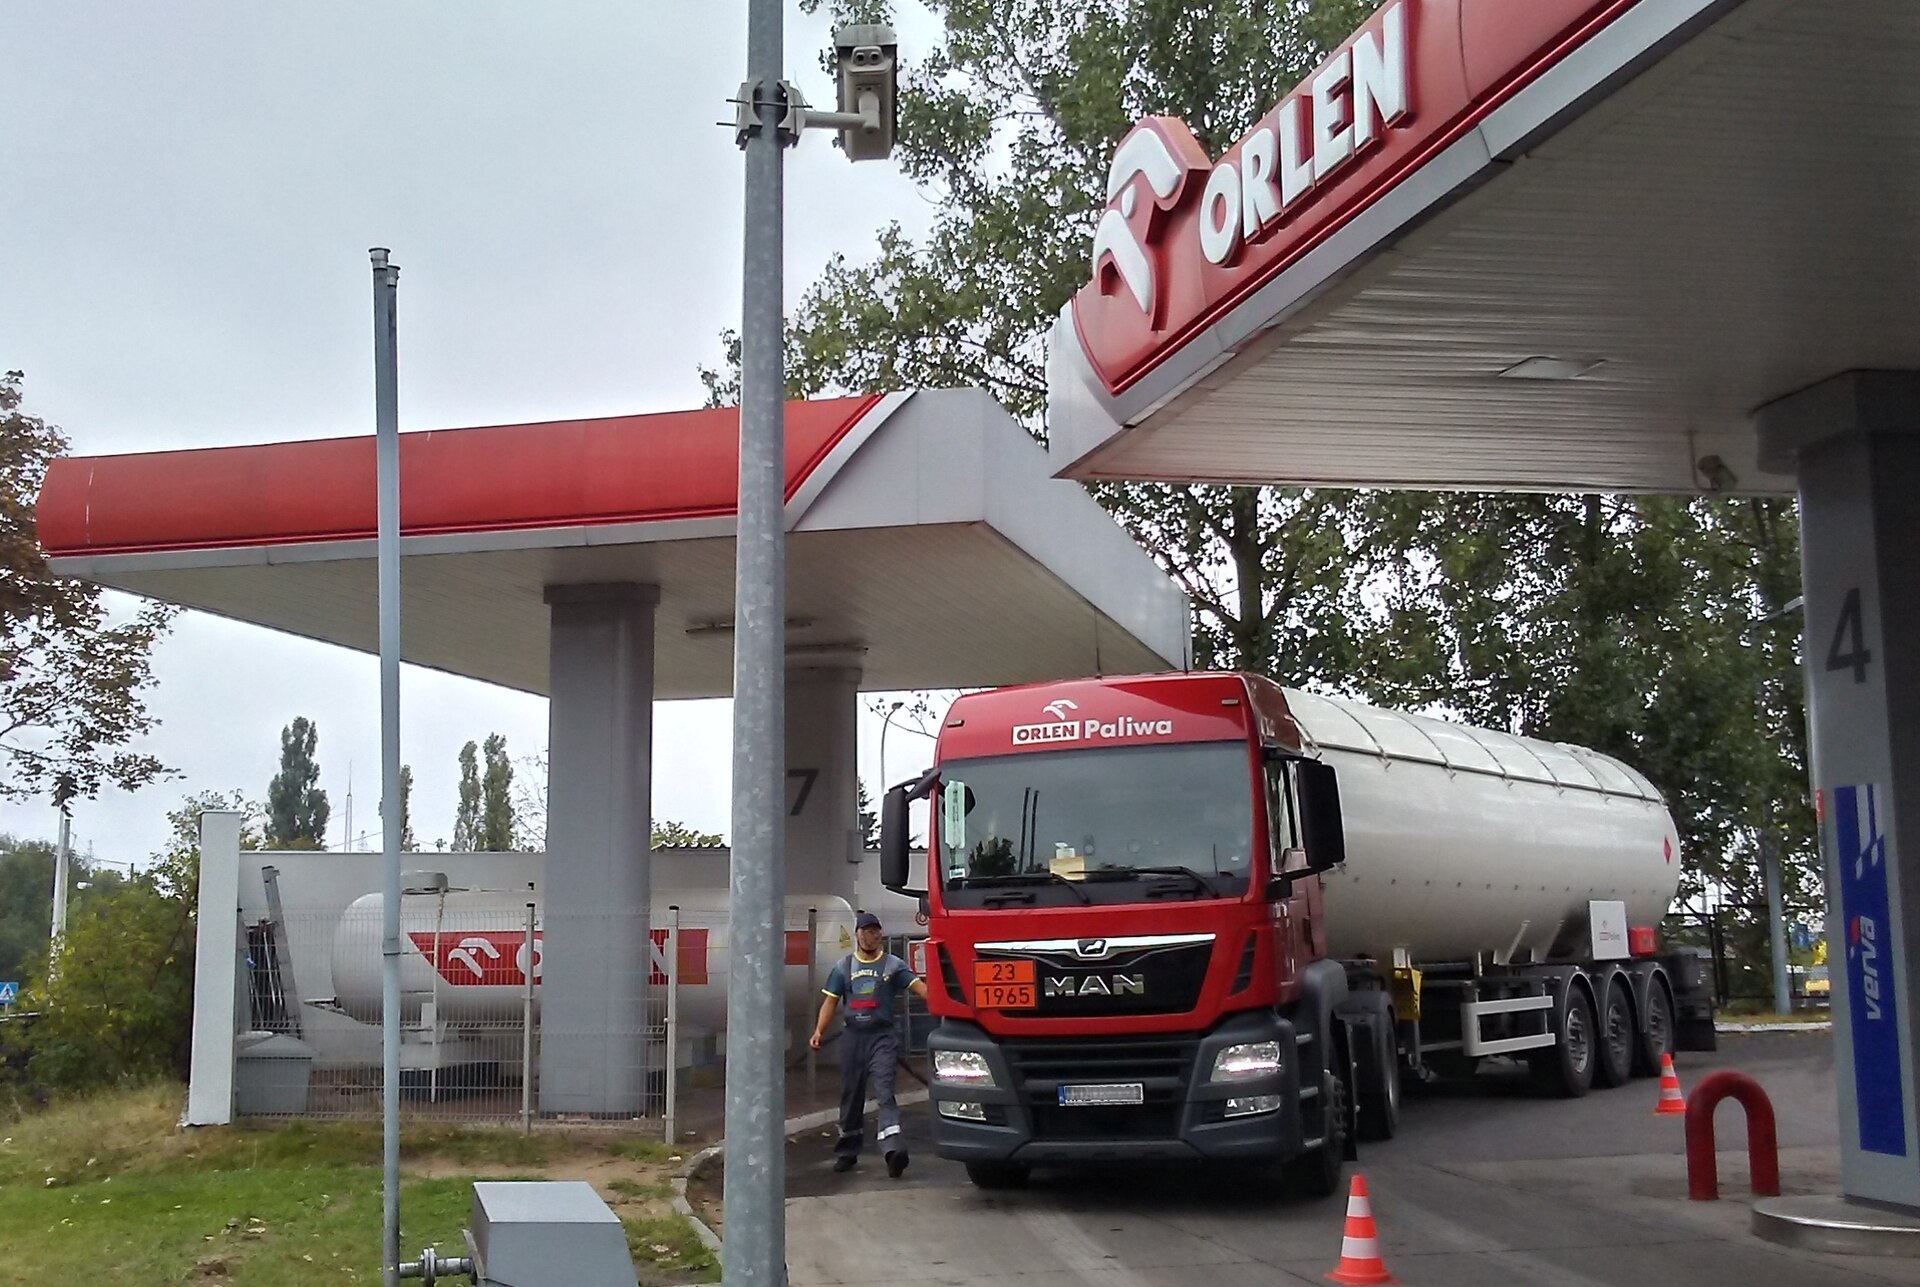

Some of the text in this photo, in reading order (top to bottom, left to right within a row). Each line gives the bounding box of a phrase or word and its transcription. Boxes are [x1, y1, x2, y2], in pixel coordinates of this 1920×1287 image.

[1199, 2, 1408, 265] ORLEN
[1825, 587, 1872, 684] 4
[1016, 716, 1173, 741] ORLEN Paliwa
[788, 768, 819, 816] 7
[992, 963, 1016, 981] 23
[1044, 974, 1145, 997] MAN
[1860, 916, 1881, 1020] verva
[984, 987, 1031, 1005] 1965
